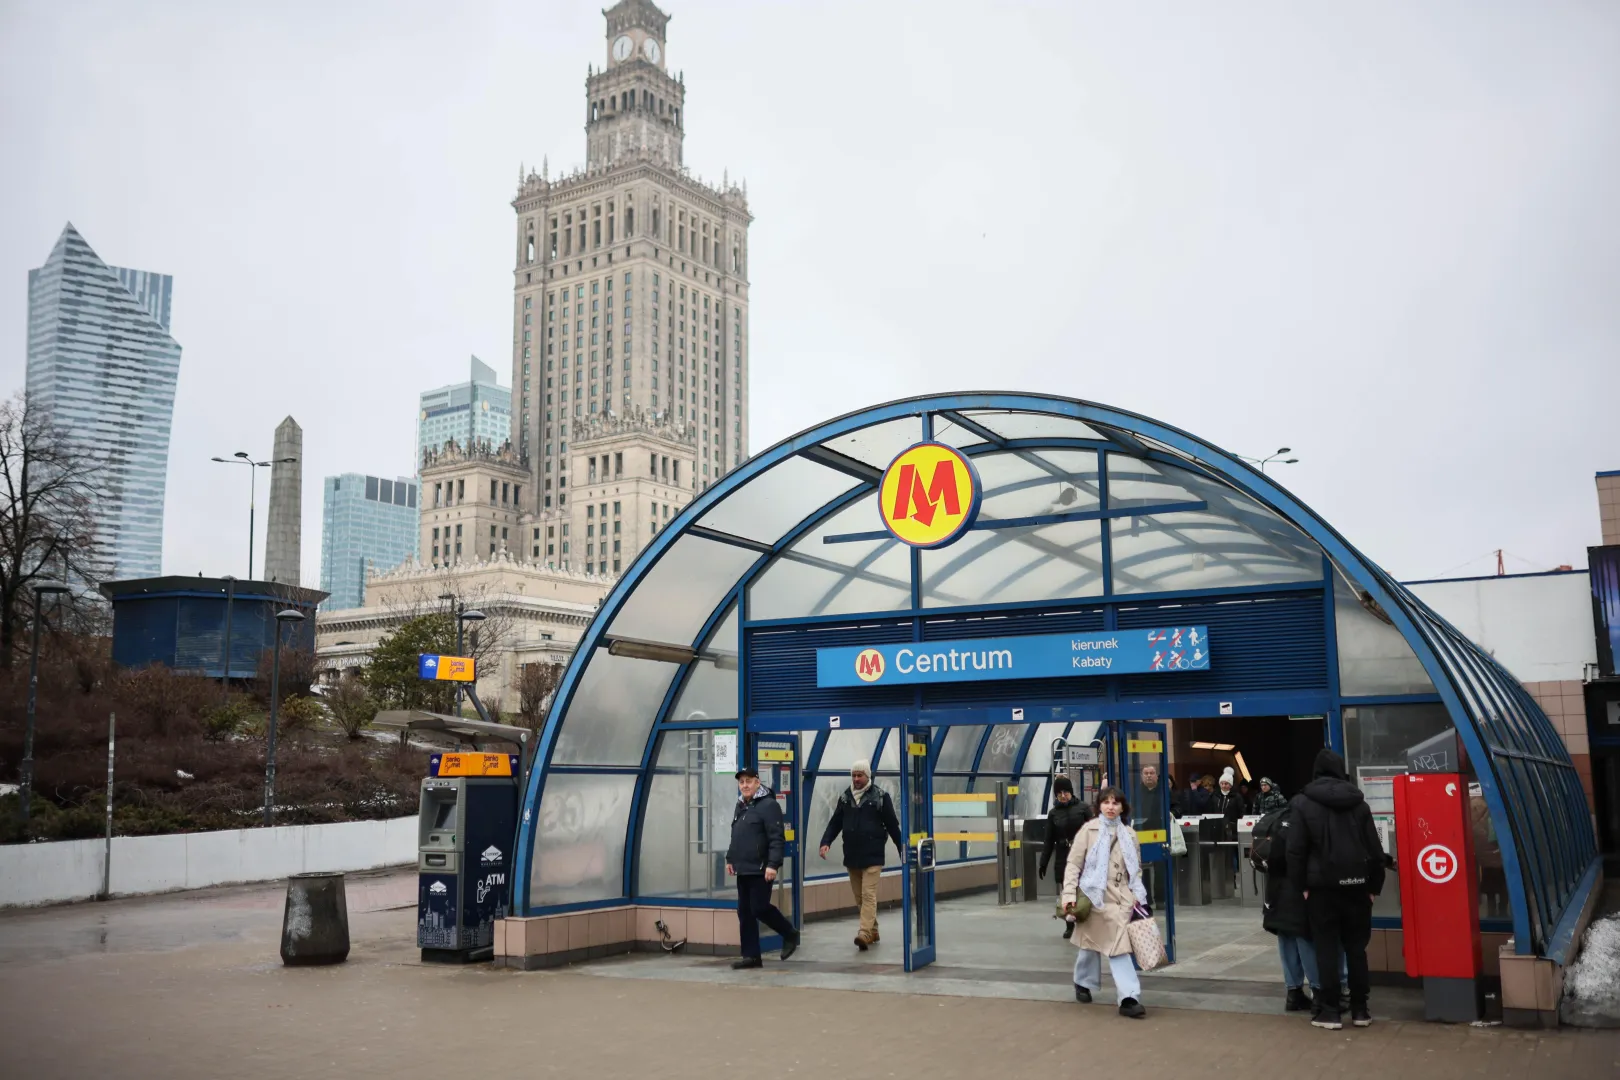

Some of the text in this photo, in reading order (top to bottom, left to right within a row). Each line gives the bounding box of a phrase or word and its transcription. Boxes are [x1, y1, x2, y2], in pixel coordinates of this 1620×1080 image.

[1071, 637, 1119, 651] kierunek
[895, 648, 1013, 674] Centrum
[1072, 656, 1112, 669] Kabaty
[485, 873, 505, 886] ATM
[1339, 877, 1366, 885] adidas
